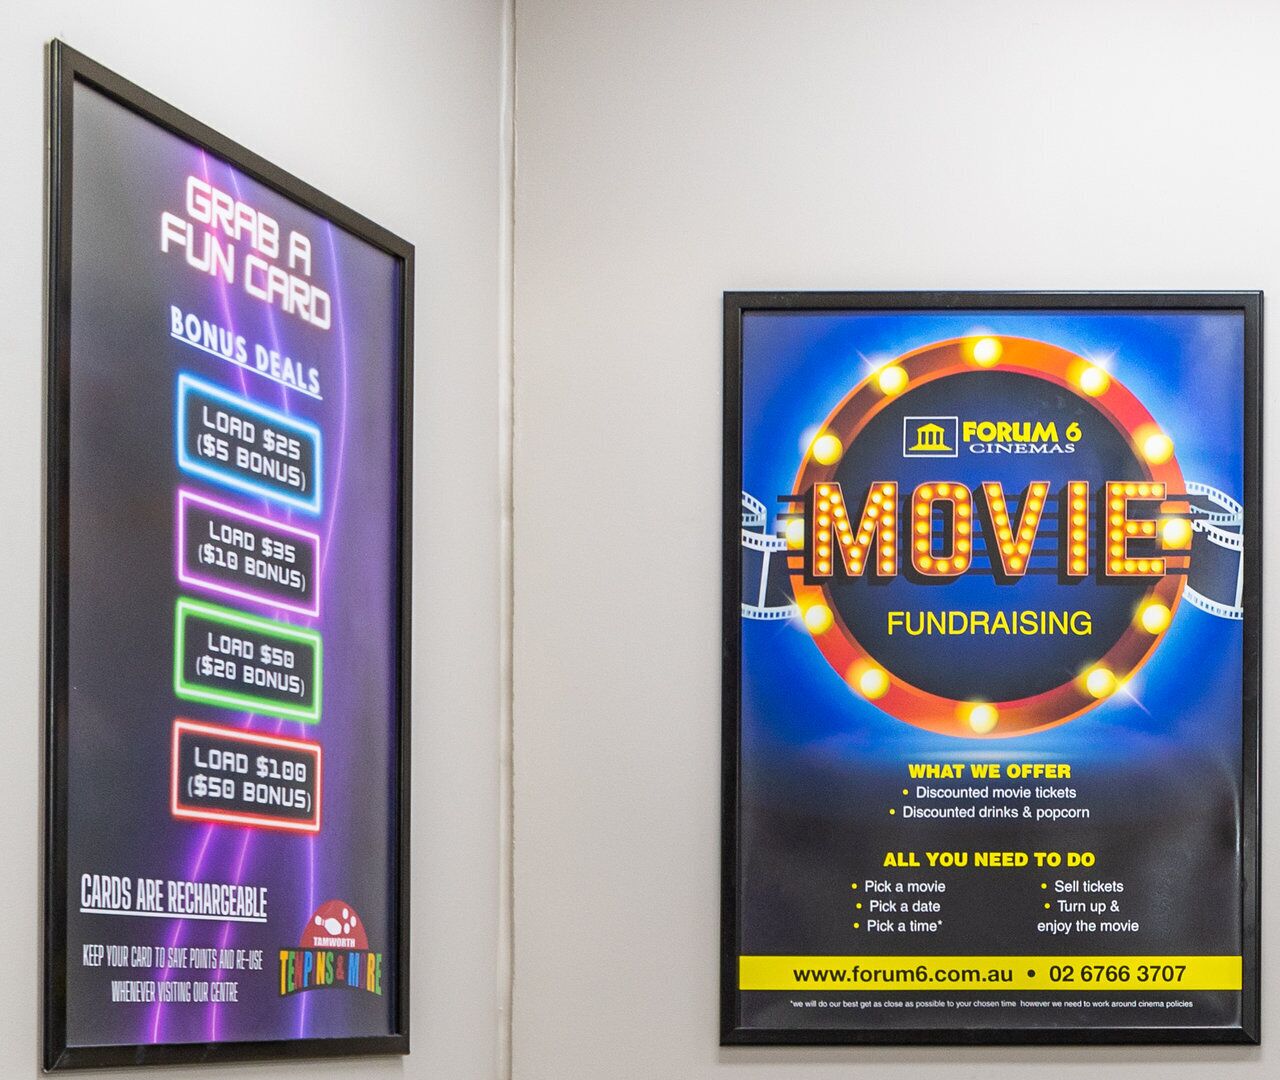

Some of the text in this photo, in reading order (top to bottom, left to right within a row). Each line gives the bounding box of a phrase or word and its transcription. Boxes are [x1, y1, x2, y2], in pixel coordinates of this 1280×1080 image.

[186, 175, 311, 276] GRAB A
[161, 211, 331, 330] FUN CARD
[171, 305, 320, 395] BONUS DEALS
[962, 421, 1082, 442] FORUM 6
[969, 442, 1075, 453] CINEMAS
[812, 481, 1167, 577] MOVIE
[887, 610, 1093, 635] FUNDRAISING
[194, 746, 306, 782] LOAD $100
[908, 763, 1070, 778] WHAT WE OFFER
[187, 773, 311, 812] ($50 BONUS)
[916, 785, 1077, 798] Discounted movie tickets
[81, 873, 267, 920] CARDS ARE RECHARGEABLE
[792, 965, 1186, 982] www.forum6.com.au 02 6766 3707
